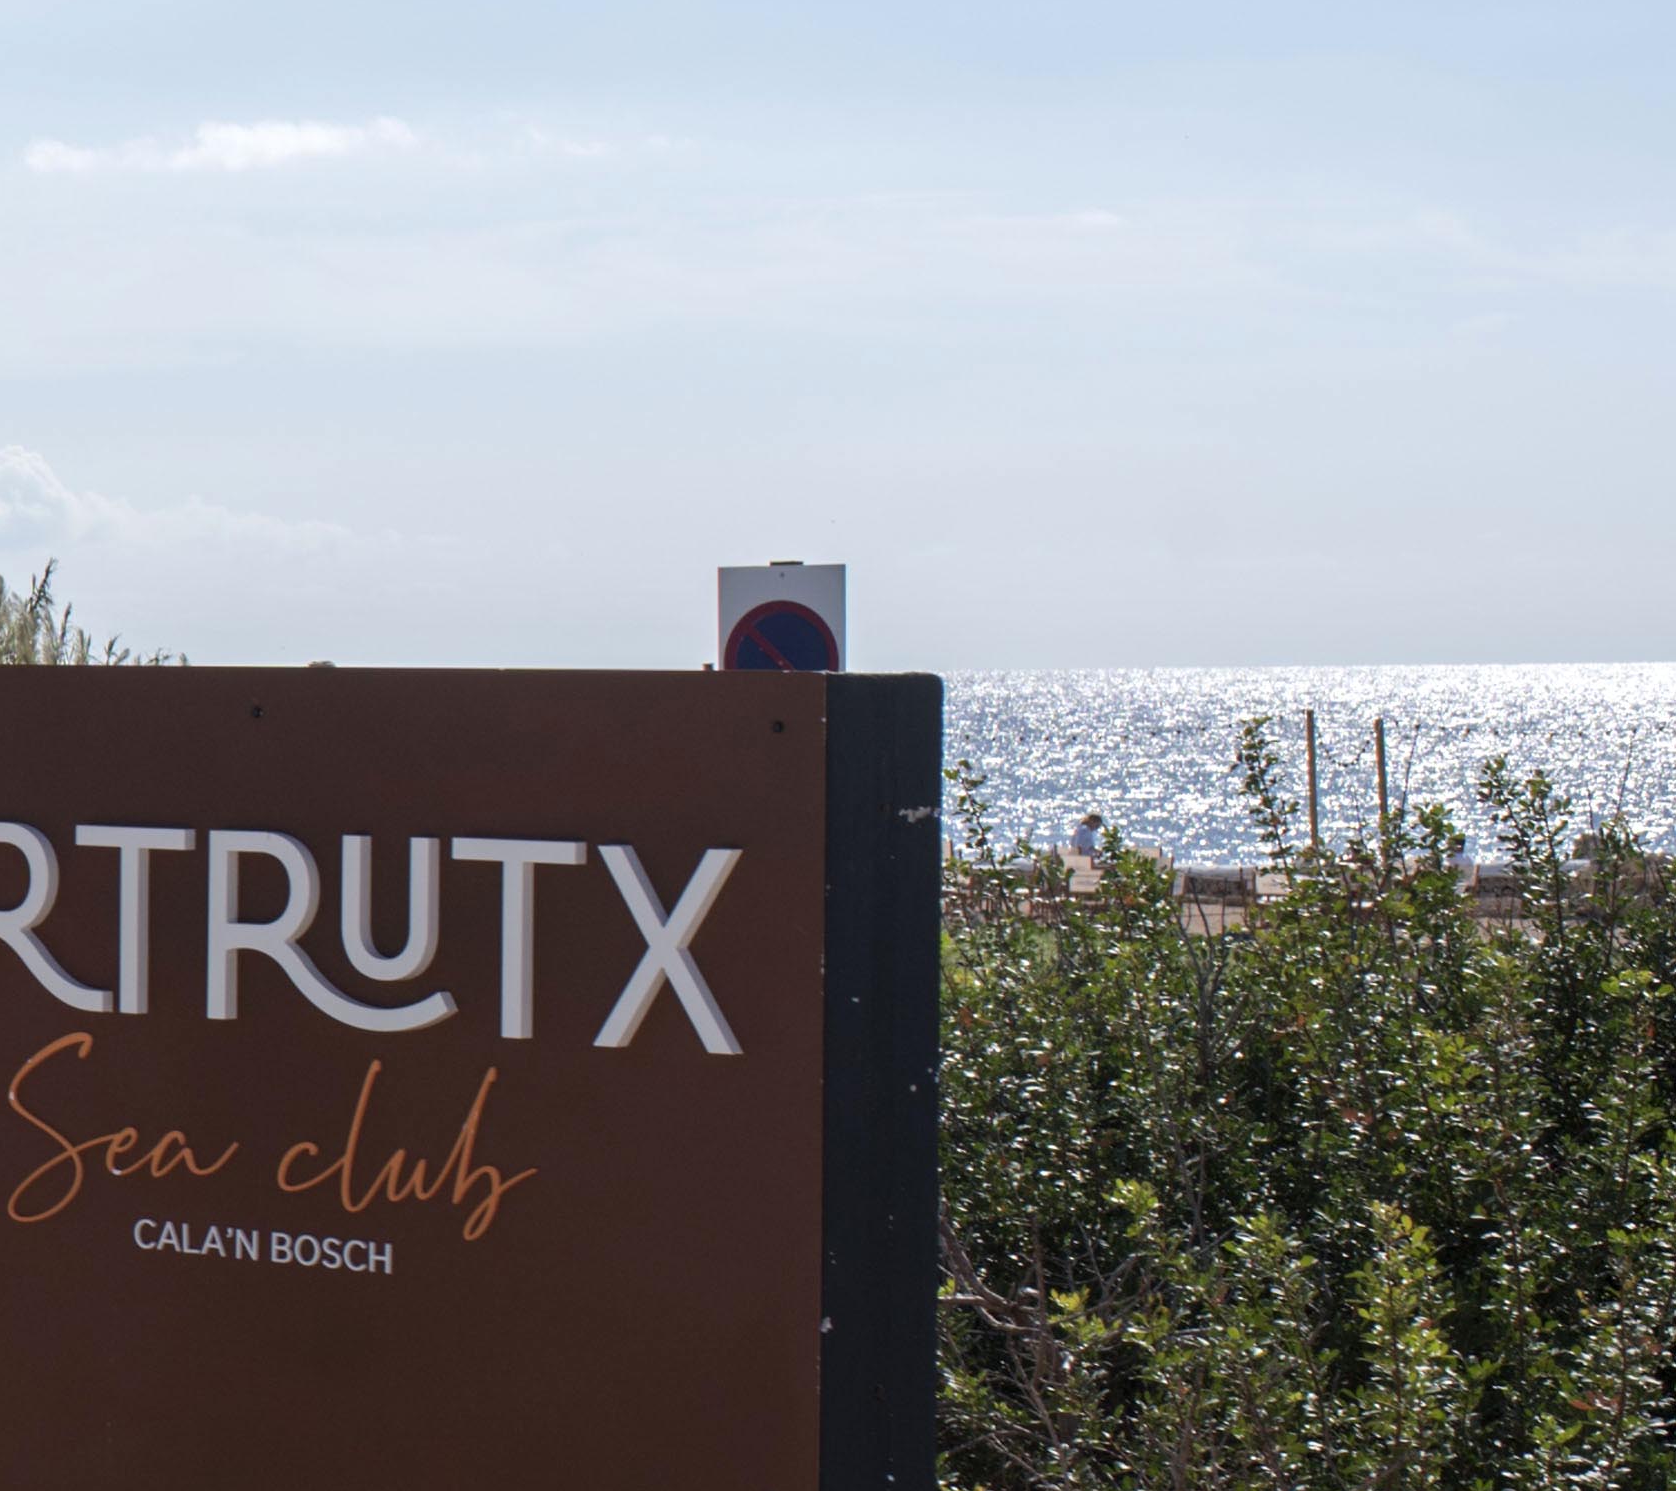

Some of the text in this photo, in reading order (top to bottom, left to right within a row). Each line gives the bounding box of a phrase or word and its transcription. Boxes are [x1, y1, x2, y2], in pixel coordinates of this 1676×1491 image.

[7, 1033, 537, 1241] Sea club
[270, 1231, 394, 1275] BOSCH
